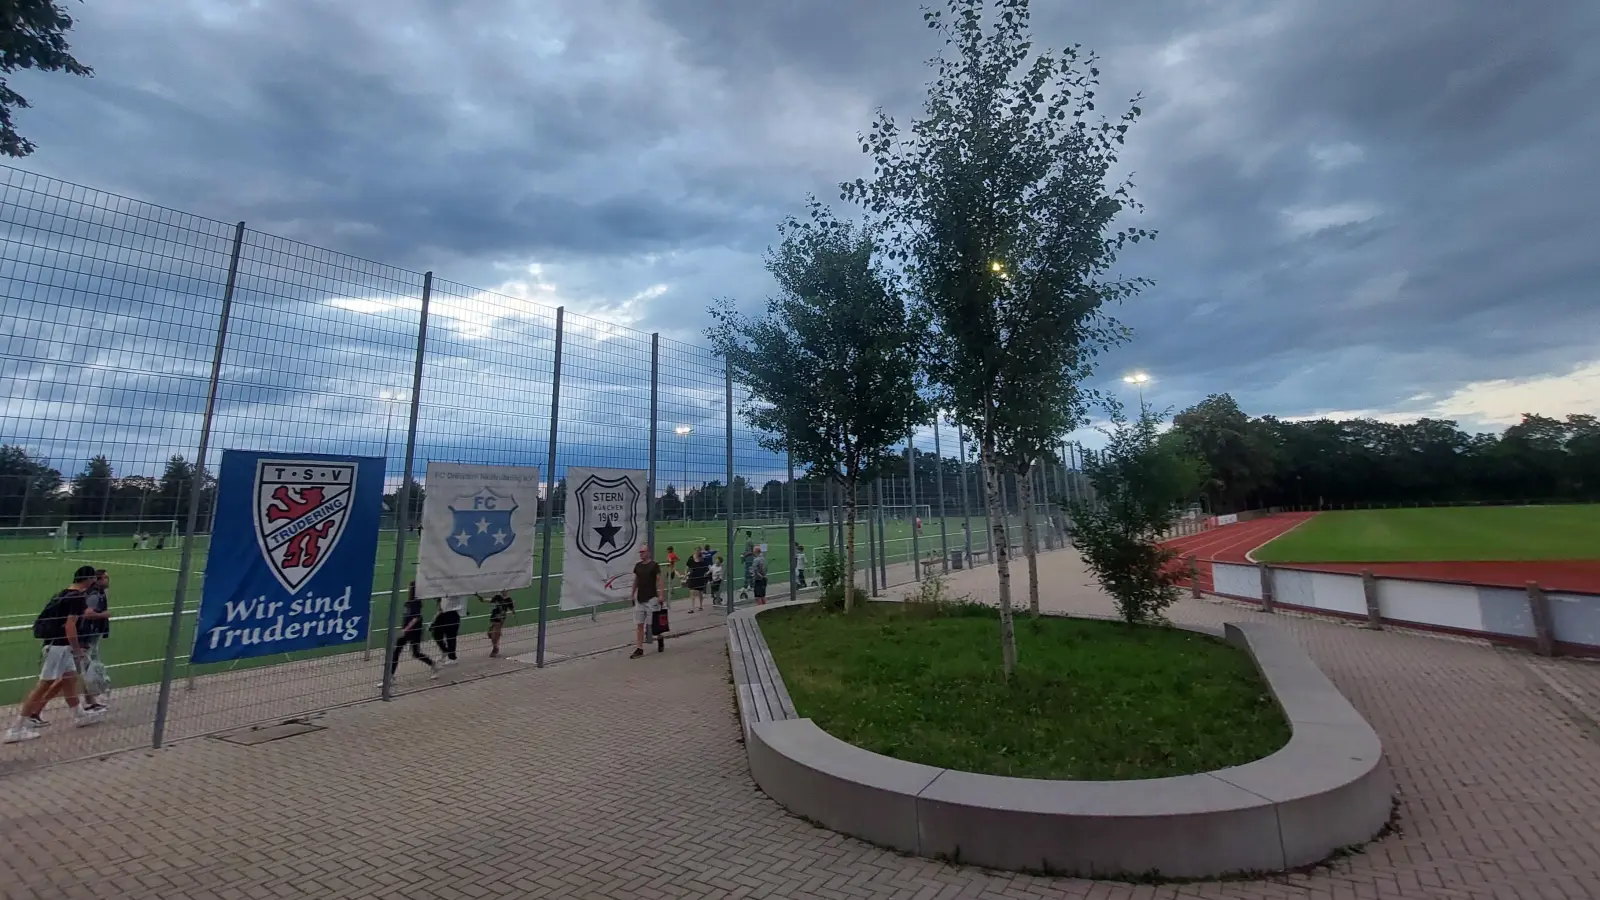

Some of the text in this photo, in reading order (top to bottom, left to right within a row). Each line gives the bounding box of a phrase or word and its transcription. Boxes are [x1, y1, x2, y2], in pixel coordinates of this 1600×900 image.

[474, 496, 497, 510] FC
[593, 492, 624, 502] STERN
[594, 503, 624, 511] MÜNCHEN
[270, 499, 343, 545] TRUDERING
[598, 512, 619, 522] 1919
[225, 586, 352, 623] Wir sind
[207, 613, 363, 650] Trudering
